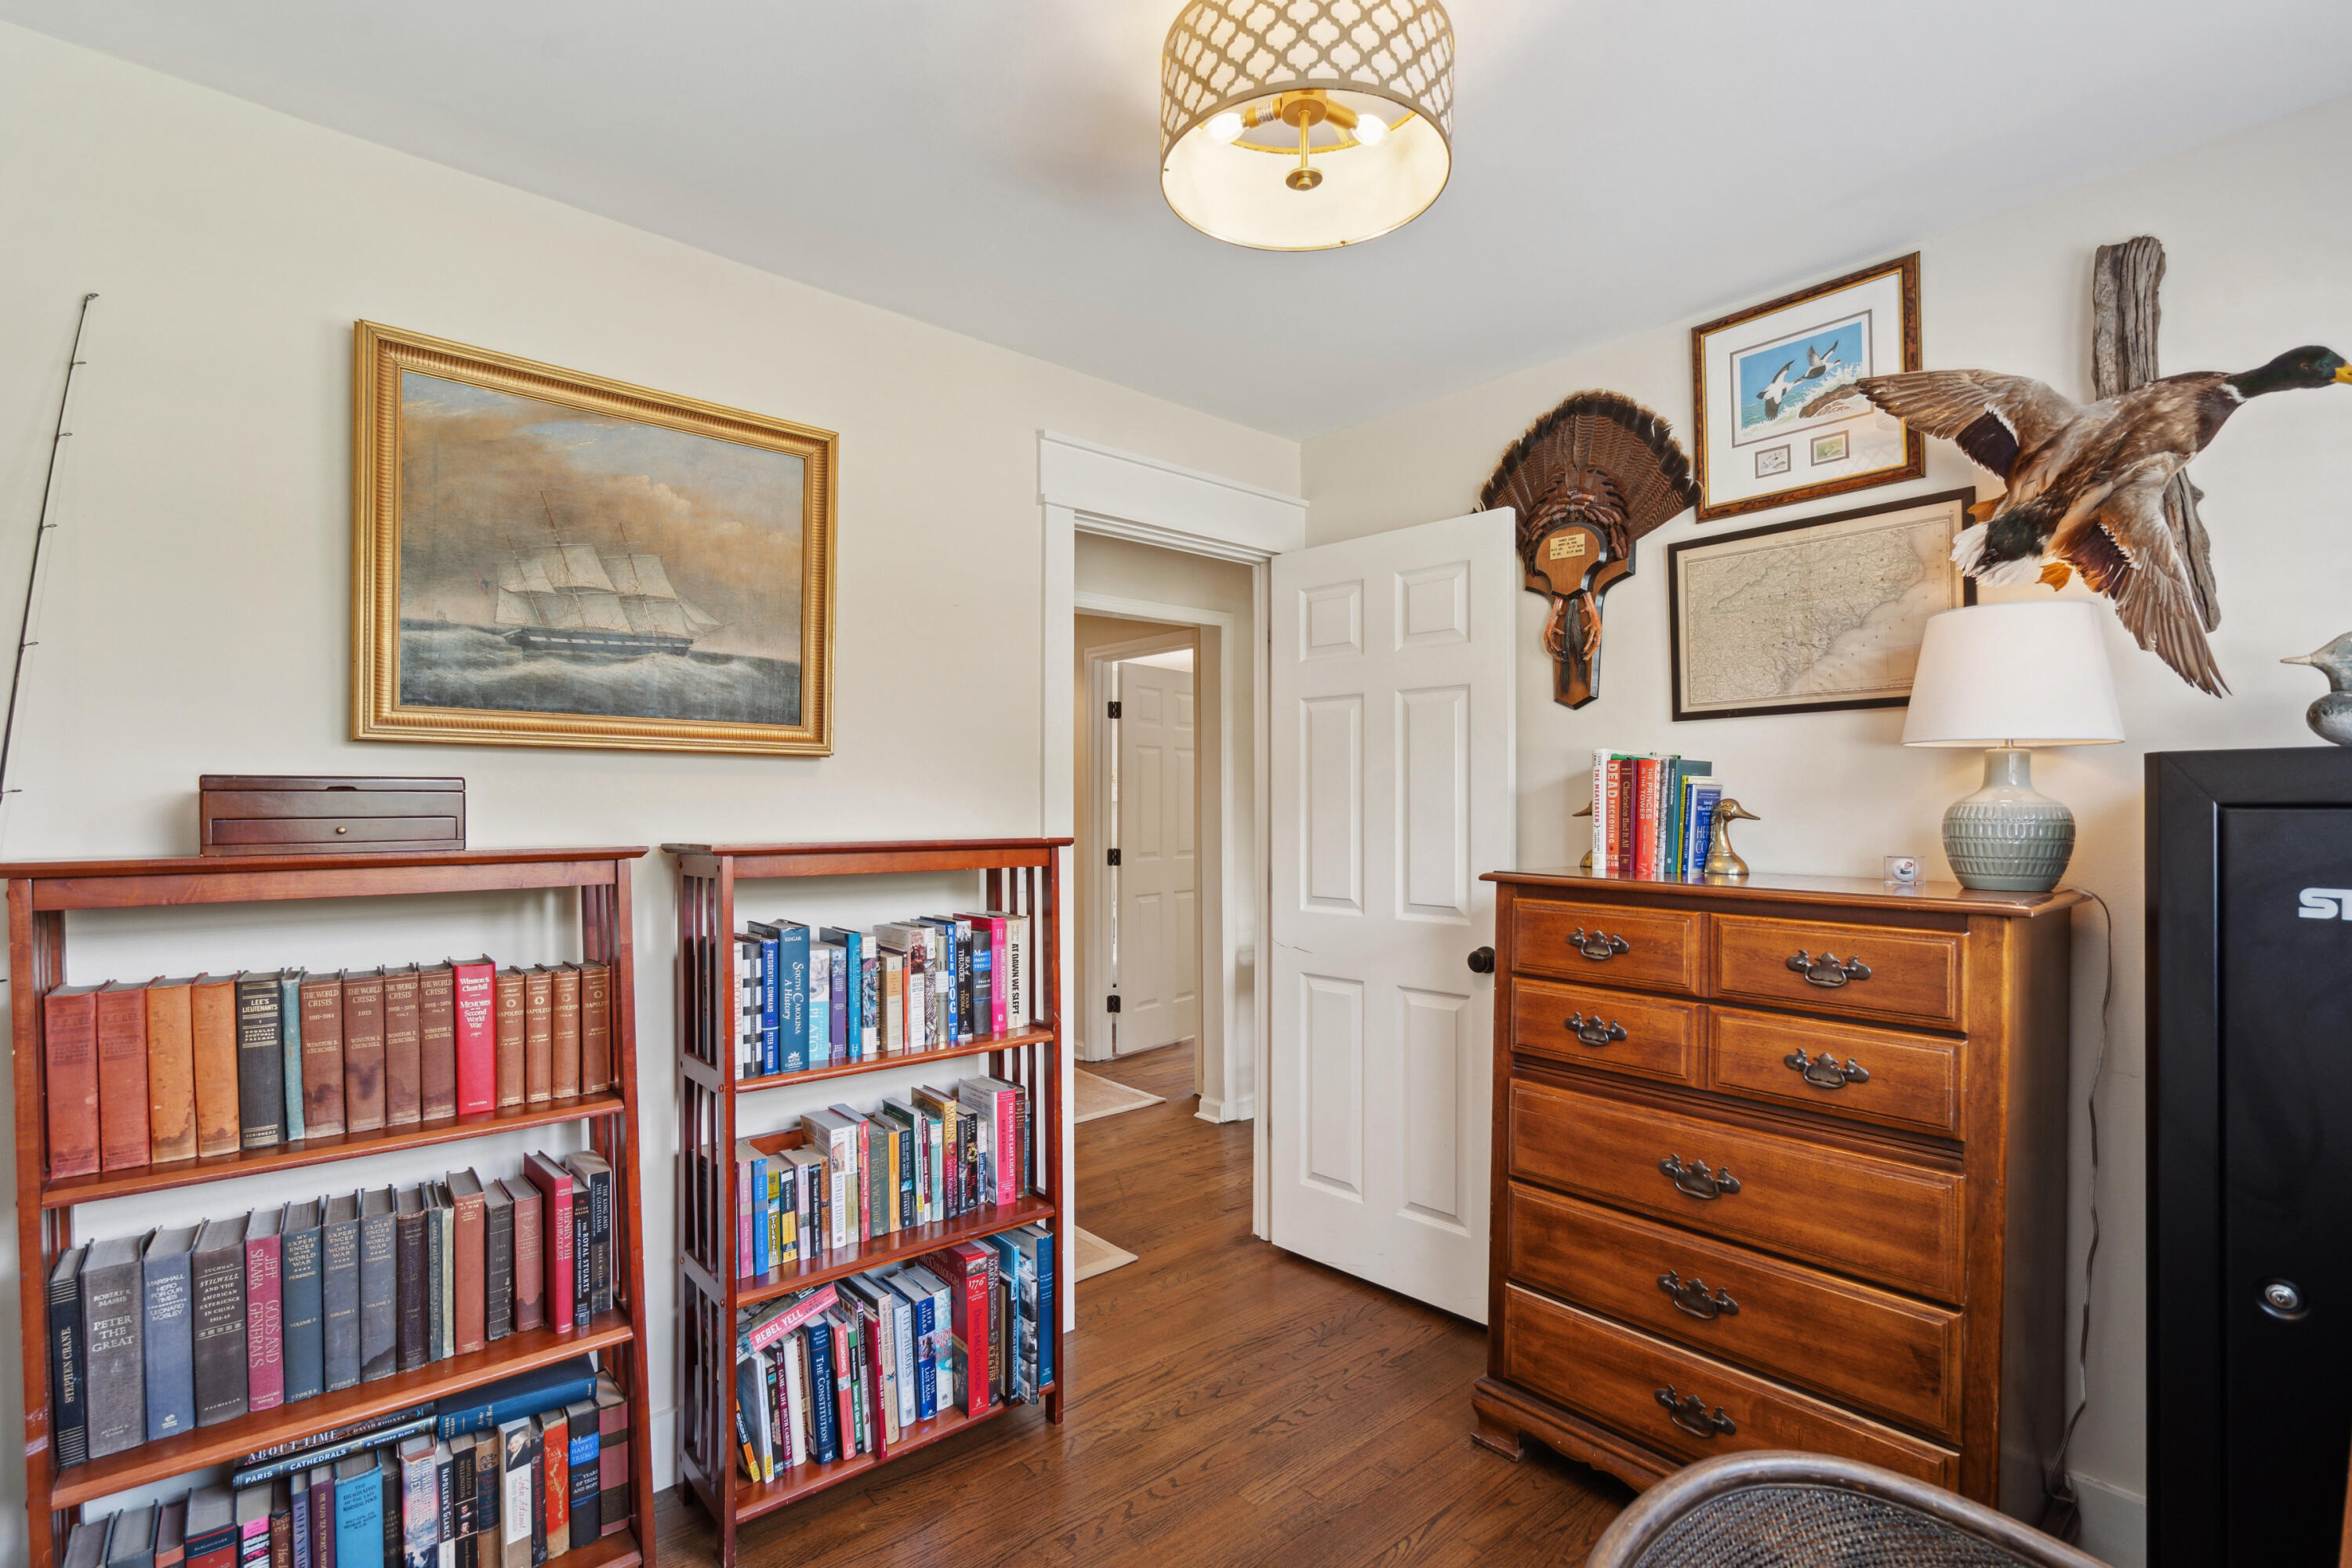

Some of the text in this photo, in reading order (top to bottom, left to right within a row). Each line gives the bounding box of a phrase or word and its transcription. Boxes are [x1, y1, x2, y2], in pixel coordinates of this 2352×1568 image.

[1608, 764, 1619, 798] DEAD
[1012, 943, 1019, 952] AT
[462, 983, 488, 992] Churchill
[1012, 978, 1019, 992] WE
[315, 989, 339, 998] WORLD
[389, 991, 412, 1000] CRISIS
[426, 988, 448, 996] CRISIS
[792, 962, 804, 1035] SOUTH CAROLINA
[308, 999, 333, 1007] CRISIS
[353, 995, 376, 1004] CRISIS
[459, 1000, 491, 1008] MEMOIRS
[782, 989, 793, 1019] History
[242, 1004, 278, 1013] LIEUTENANTS
[1009, 1134, 1014, 1142] AT
[872, 1185, 880, 1223] VICTORY
[564, 1206, 572, 1240] HENRY
[366, 1228, 390, 1236] ENCES
[329, 1235, 354, 1243] ENCES
[365, 1236, 391, 1246] WORLD
[289, 1243, 314, 1252] ENCES
[328, 1244, 355, 1254] WORLD
[564, 1242, 572, 1260] VIII
[288, 1253, 317, 1262] WORLD
[205, 1263, 234, 1274] TUCHMAN
[250, 1249, 264, 1290] SHAARA
[265, 1254, 278, 1278] JEFF
[147, 1273, 186, 1287] MARSHALL
[199, 1273, 239, 1287] STILWELL
[968, 1277, 985, 1290] 1776
[157, 1283, 177, 1292] HERO
[164, 1287, 183, 1296] OUR
[93, 1290, 124, 1301] ROBERT
[157, 1294, 178, 1303] TIMES
[202, 1289, 238, 1301] AMERICAN
[150, 1302, 185, 1316] LEONARD
[200, 1296, 241, 1310] EXPERIENCE
[152, 1309, 183, 1322] MOSLEY
[93, 1316, 132, 1331] PETER
[754, 1309, 804, 1345] REBEL YELL
[100, 1327, 127, 1339] THE
[249, 1302, 264, 1369] GENERALS
[265, 1300, 281, 1363] GODS AND
[92, 1336, 135, 1352] GREAT
[904, 1338, 913, 1377] HEROES
[61, 1326, 74, 1404] STEPHEN CRANE
[930, 1367, 935, 1379] TO
[818, 1376, 828, 1443] CONSTITUTION
[353, 1423, 376, 1433] DAVID
[248, 1428, 339, 1463] ABOUT TIME
[245, 1428, 416, 1484] PARIS CATHEDRALS HOWARD BLOCH
[422, 1475, 433, 1494] WAR
[583, 1476, 598, 1486] TRIAL
[441, 1467, 452, 1539] NAPOLEON'S GLANCE
[517, 1476, 530, 1529] John Adams
